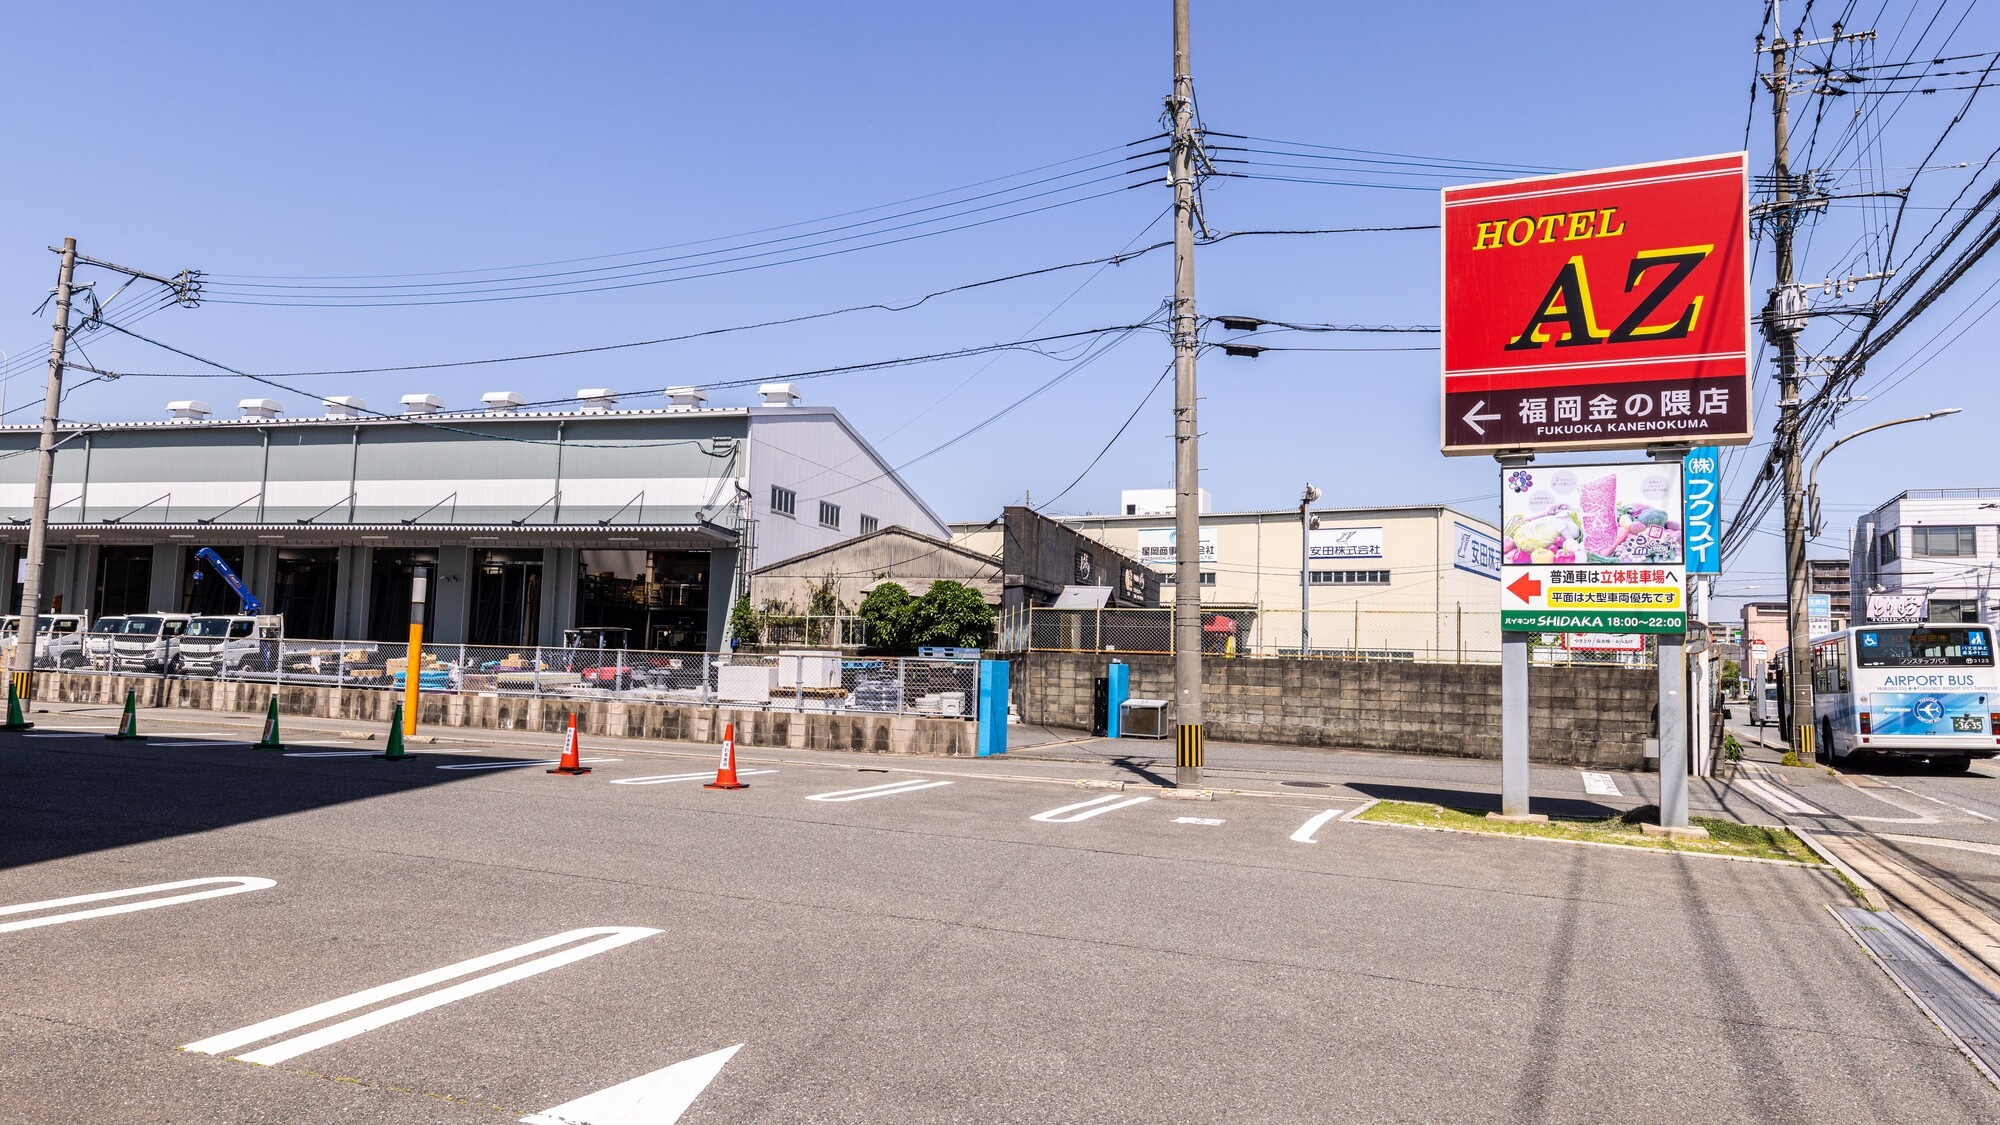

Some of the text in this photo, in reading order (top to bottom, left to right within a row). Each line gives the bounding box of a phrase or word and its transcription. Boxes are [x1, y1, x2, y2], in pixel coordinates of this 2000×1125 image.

[1472, 206, 1627, 251] HOTEL
[1503, 244, 1715, 352] AZ
[1518, 387, 1729, 424] 福岡金の隈店
[1537, 419, 1709, 436] FUKUOKA KANENOKUMA
[1142, 545, 1215, 556] 星岡商事会社
[1309, 544, 1381, 556] 安田株式会社
[1550, 569, 1678, 584] 普通車は立体駐車場へ
[1552, 592, 1676, 604] 平面は大型車両優先です
[1505, 617, 1536, 625] バイキング
[1537, 615, 1603, 627] SHIDAKA
[1884, 675, 1974, 686] AIRPORT BUS
[1958, 721, 1982, 729] 36-35
